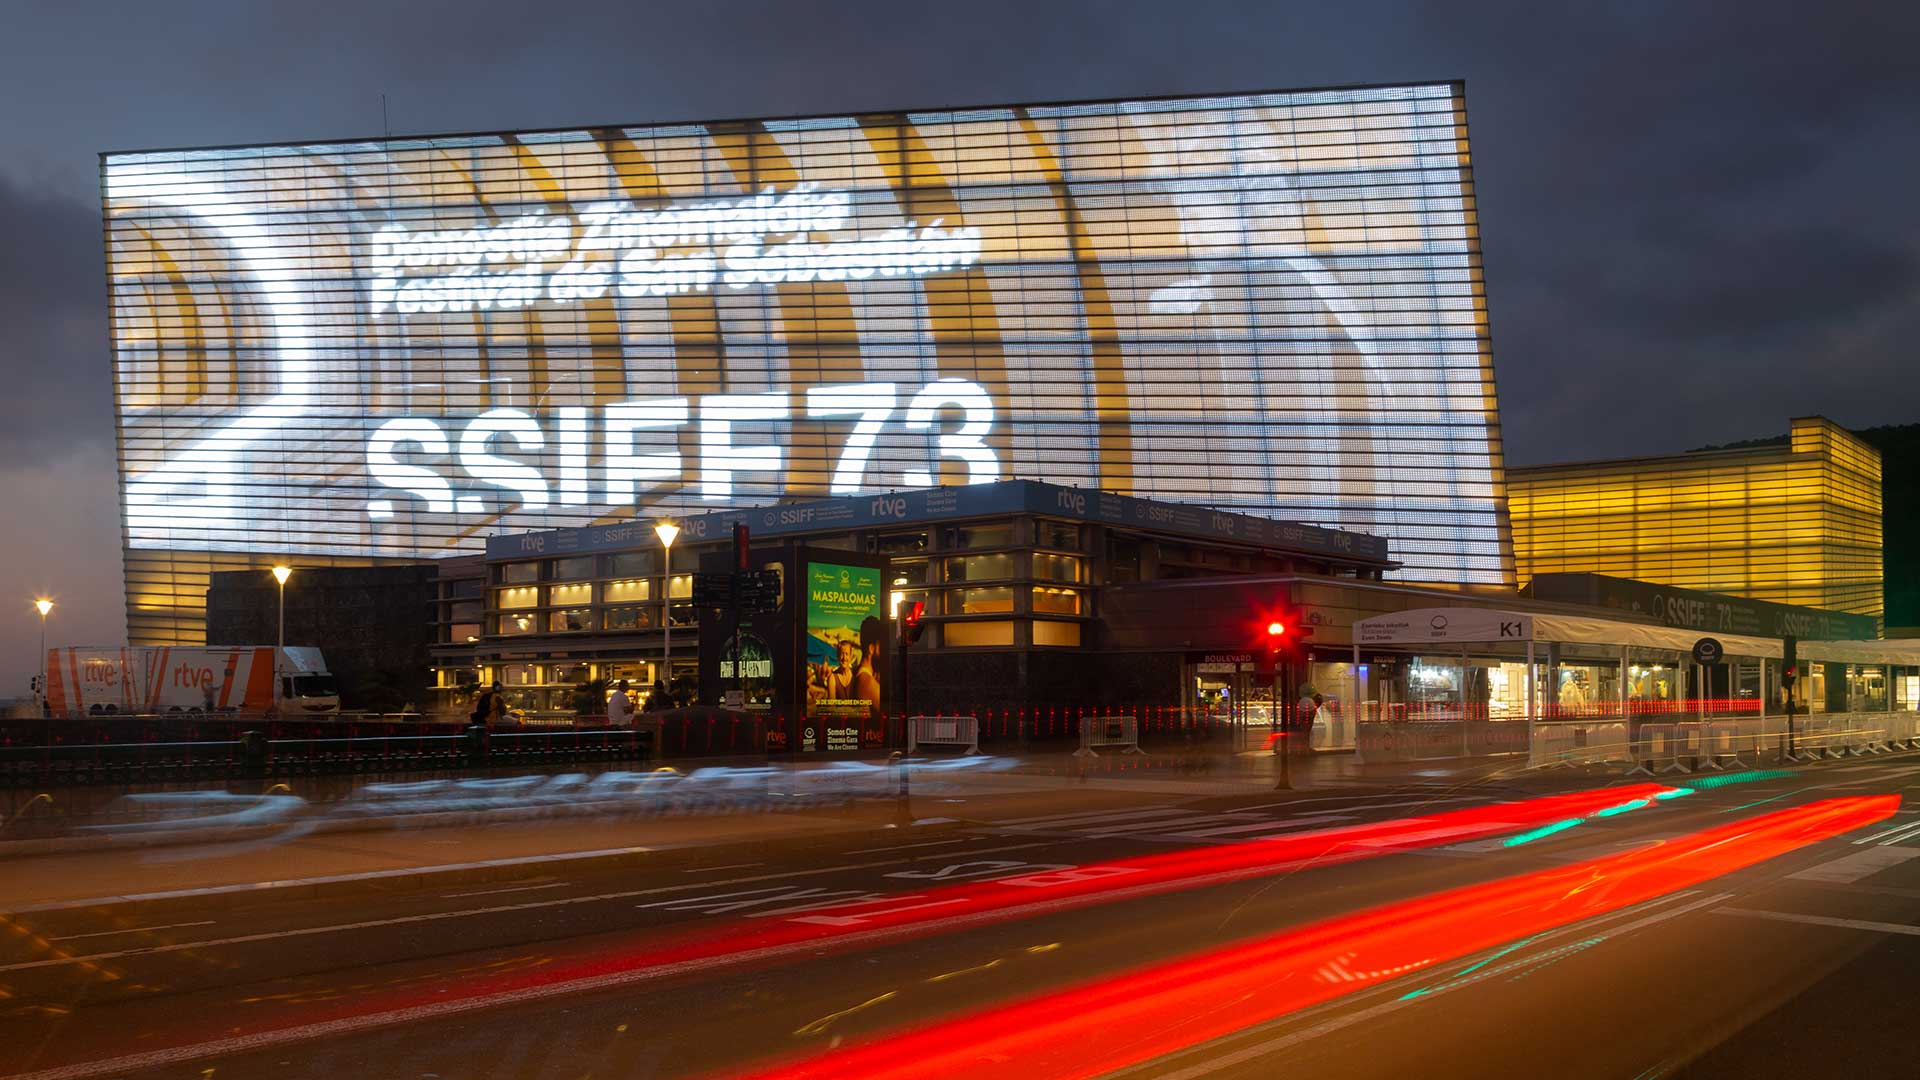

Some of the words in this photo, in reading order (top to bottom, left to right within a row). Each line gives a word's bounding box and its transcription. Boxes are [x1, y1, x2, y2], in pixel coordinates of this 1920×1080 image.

[366, 391, 789, 518] SSIFF
[806, 378, 1001, 497] 73
[872, 496, 906, 518] rtve
[1057, 488, 1085, 514] rtve
[780, 507, 816, 527] SSIFF
[1149, 507, 1175, 523] SSIFF
[1212, 513, 1234, 536] rtve
[521, 534, 545, 553] rtve
[605, 528, 633, 542] SSIFF
[1333, 533, 1351, 550] rtve
[812, 590, 877, 606] MASPALOMAS
[1667, 597, 1706, 627] SSIFF
[1717, 603, 1732, 631] 73
[1500, 621, 1523, 637] K1
[1204, 654, 1252, 663] BOULEVARD
[85, 661, 114, 687] rtve
[174, 661, 215, 690] rtve
[827, 728, 845, 736] Somos
[846, 728, 858, 736] Cine
